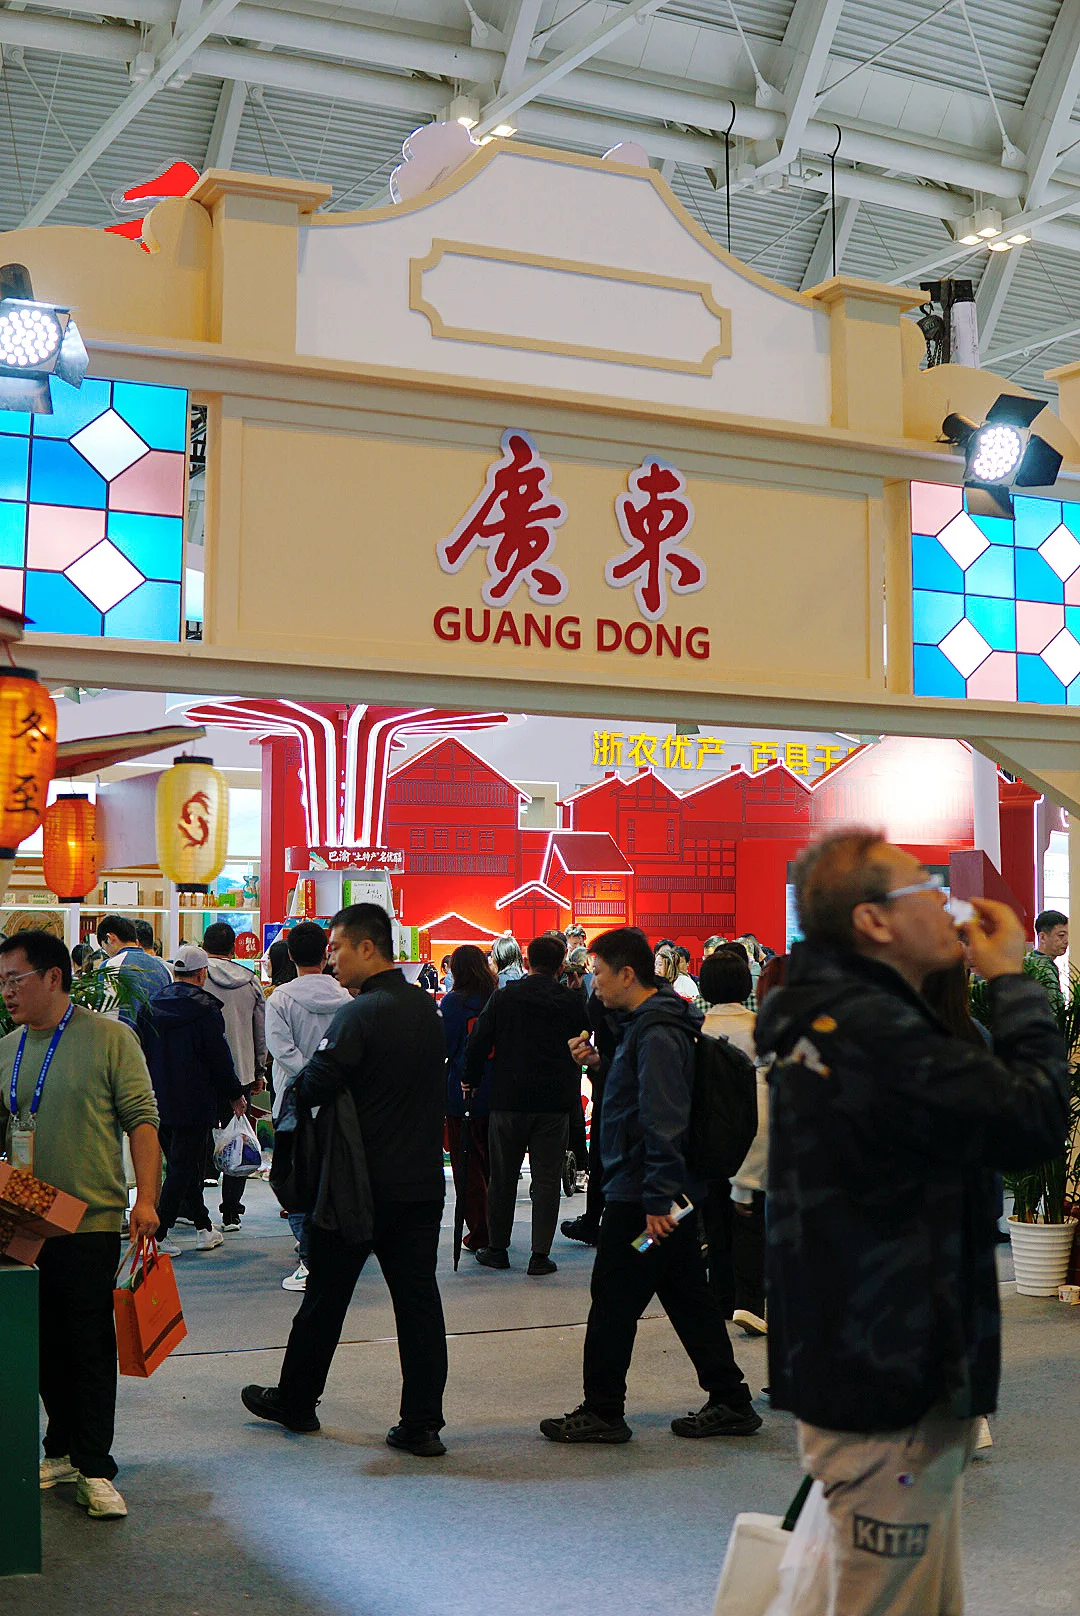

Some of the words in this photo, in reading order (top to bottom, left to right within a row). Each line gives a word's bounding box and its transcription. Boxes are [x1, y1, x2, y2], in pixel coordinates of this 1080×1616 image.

[443, 434, 702, 614] 廣東
[433, 606, 581, 650] GUANG
[597, 618, 710, 660] DONG
[5, 710, 50, 816] 冬至
[592, 729, 726, 770] 浙农优产
[751, 741, 863, 776] 百县千
[857, 1517, 927, 1555] KITH
